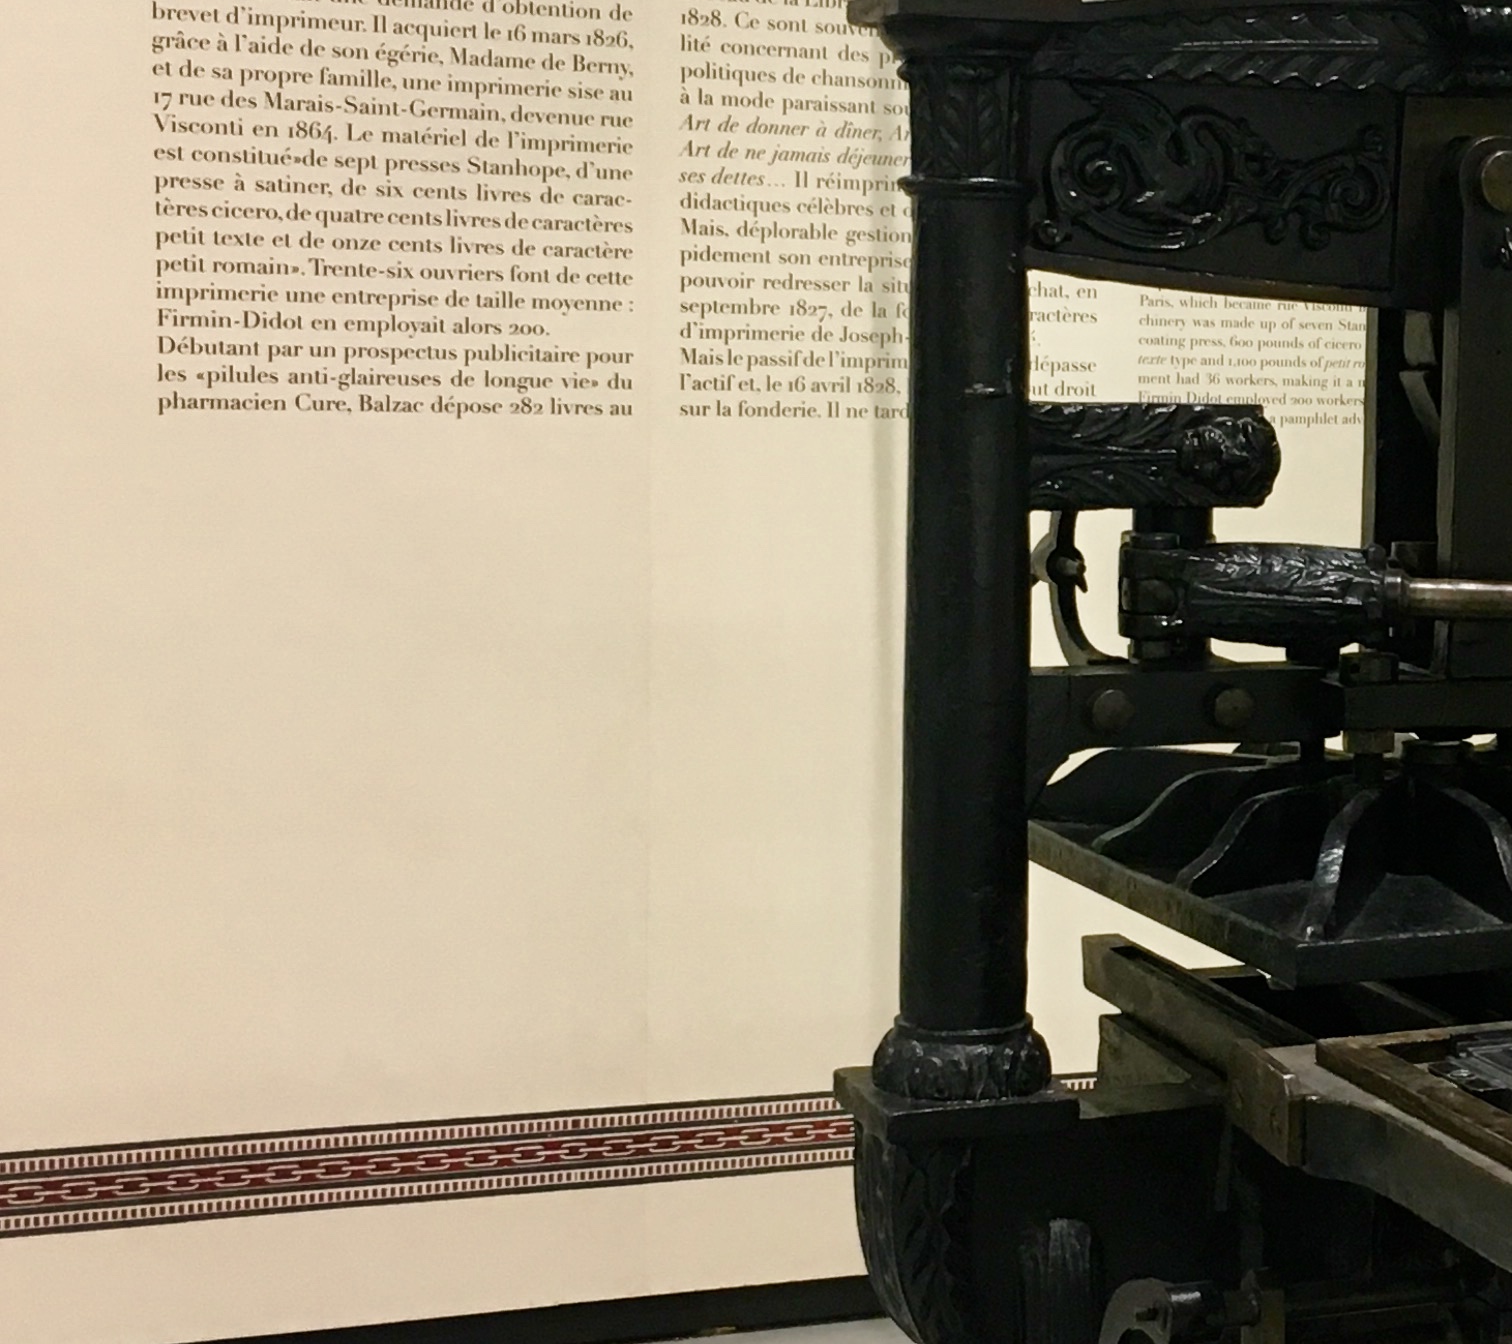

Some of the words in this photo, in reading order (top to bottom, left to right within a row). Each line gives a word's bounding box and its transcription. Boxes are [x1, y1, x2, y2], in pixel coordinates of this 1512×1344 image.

[151, 0, 219, 23] brevet
[225, 5, 367, 33] d'imprimeur.
[371, 14, 387, 33] Il
[392, 19, 477, 42] acquiert
[483, 21, 501, 40] le
[507, 23, 526, 41] 16
[531, 30, 581, 45] mars
[585, 28, 633, 50] 1826,
[608, 2, 633, 21] de
[681, 7, 726, 27] 1828.
[734, 10, 760, 29] Ce
[767, 18, 806, 32] sont
[151, 30, 210, 54] grâce
[216, 31, 228, 51] à
[234, 33, 293, 55] l'aide
[299, 37, 325, 57] de
[331, 46, 369, 59] son
[374, 41, 443, 68] égérie,
[449, 46, 535, 68] Madame
[540, 52, 565, 70] de
[572, 53, 633, 77] Berny,
[680, 33, 710, 52] lité
[720, 42, 827, 60] concernant
[837, 43, 869, 62] des
[680, 60, 776, 87] politiques
[782, 66, 805, 84] de
[153, 91, 172, 111] 17
[178, 92, 215, 106] rue
[220, 88, 257, 108] des
[263, 90, 506, 124] Marais-Saint-Germain,
[510, 103, 594, 124] devenue
[600, 114, 633, 126] rue
[152, 112, 243, 135] Visconti
[251, 124, 278, 136] en
[287, 120, 337, 143] 1864.
[346, 122, 373, 141] Le
[381, 126, 466, 145] matériel
[474, 129, 499, 146] de
[507, 130, 633, 157] l'imprimerie
[679, 113, 710, 131] Art
[716, 113, 739, 132] de
[745, 115, 809, 136] donner
[815, 120, 827, 137] à
[833, 120, 882, 142] dîner,
[153, 145, 184, 160] est
[334, 154, 378, 175] sept
[385, 157, 460, 176] presses
[466, 155, 570, 183] Stanhope,
[575, 160, 633, 179] d'une
[678, 171, 706, 183] ses
[794, 170, 807, 187] Il
[155, 225, 205, 250] petit
[213, 230, 264, 246] texte
[271, 232, 291, 247] et
[298, 230, 324, 248] de
[331, 237, 381, 250] onze
[387, 238, 443, 252] cents
[449, 235, 504, 254] livres
[511, 237, 536, 255] de
[542, 240, 633, 258] caractère
[680, 217, 729, 237] Mais,
[736, 219, 838, 243] déplorable
[155, 253, 205, 277] petit
[307, 257, 414, 278] Trente-six
[419, 262, 504, 280] ouvriers
[509, 264, 549, 282] font
[555, 265, 580, 283] de
[585, 271, 633, 284] cette
[679, 243, 770, 267] pidement
[778, 253, 810, 264] son
[679, 297, 780, 319] septembre
[789, 298, 833, 323] 1827,
[840, 299, 863, 317] de
[871, 300, 887, 318] la
[1138, 313, 1185, 331] chinery
[1192, 318, 1215, 327] was
[1220, 315, 1254, 328] made
[1259, 320, 1276, 333] up
[1280, 316, 1296, 329] of
[1298, 321, 1332, 330] seven
[156, 335, 259, 356] Débutant
[267, 344, 303, 362] par
[308, 345, 336, 357] un
[343, 345, 457, 365] prospectus
[463, 343, 580, 366] publicitaire
[586, 351, 634, 369] pour
[1138, 335, 1185, 349] coating
[1189, 337, 1225, 350] press,
[1229, 334, 1253, 347] 600
[1257, 336, 1304, 352] pounds
[1308, 337, 1324, 349] of
[1324, 341, 1362, 351] cicero
[679, 373, 735, 392] l'actif
[766, 374, 782, 392] le
[788, 375, 805, 392] 16
[810, 375, 850, 393] avril
[856, 376, 900, 394] 1828,
[157, 390, 286, 415] pharmacien
[294, 392, 352, 414] Cure,
[358, 393, 424, 413] Balzac
[429, 394, 503, 419] dépose
[509, 396, 543, 414] 282
[549, 396, 603, 415] livres
[609, 403, 632, 416] au
[679, 404, 711, 416] sur
[716, 399, 731, 417] la
[737, 399, 821, 418] fonderie.
[826, 400, 839, 418] Il
[845, 406, 868, 418] ne
